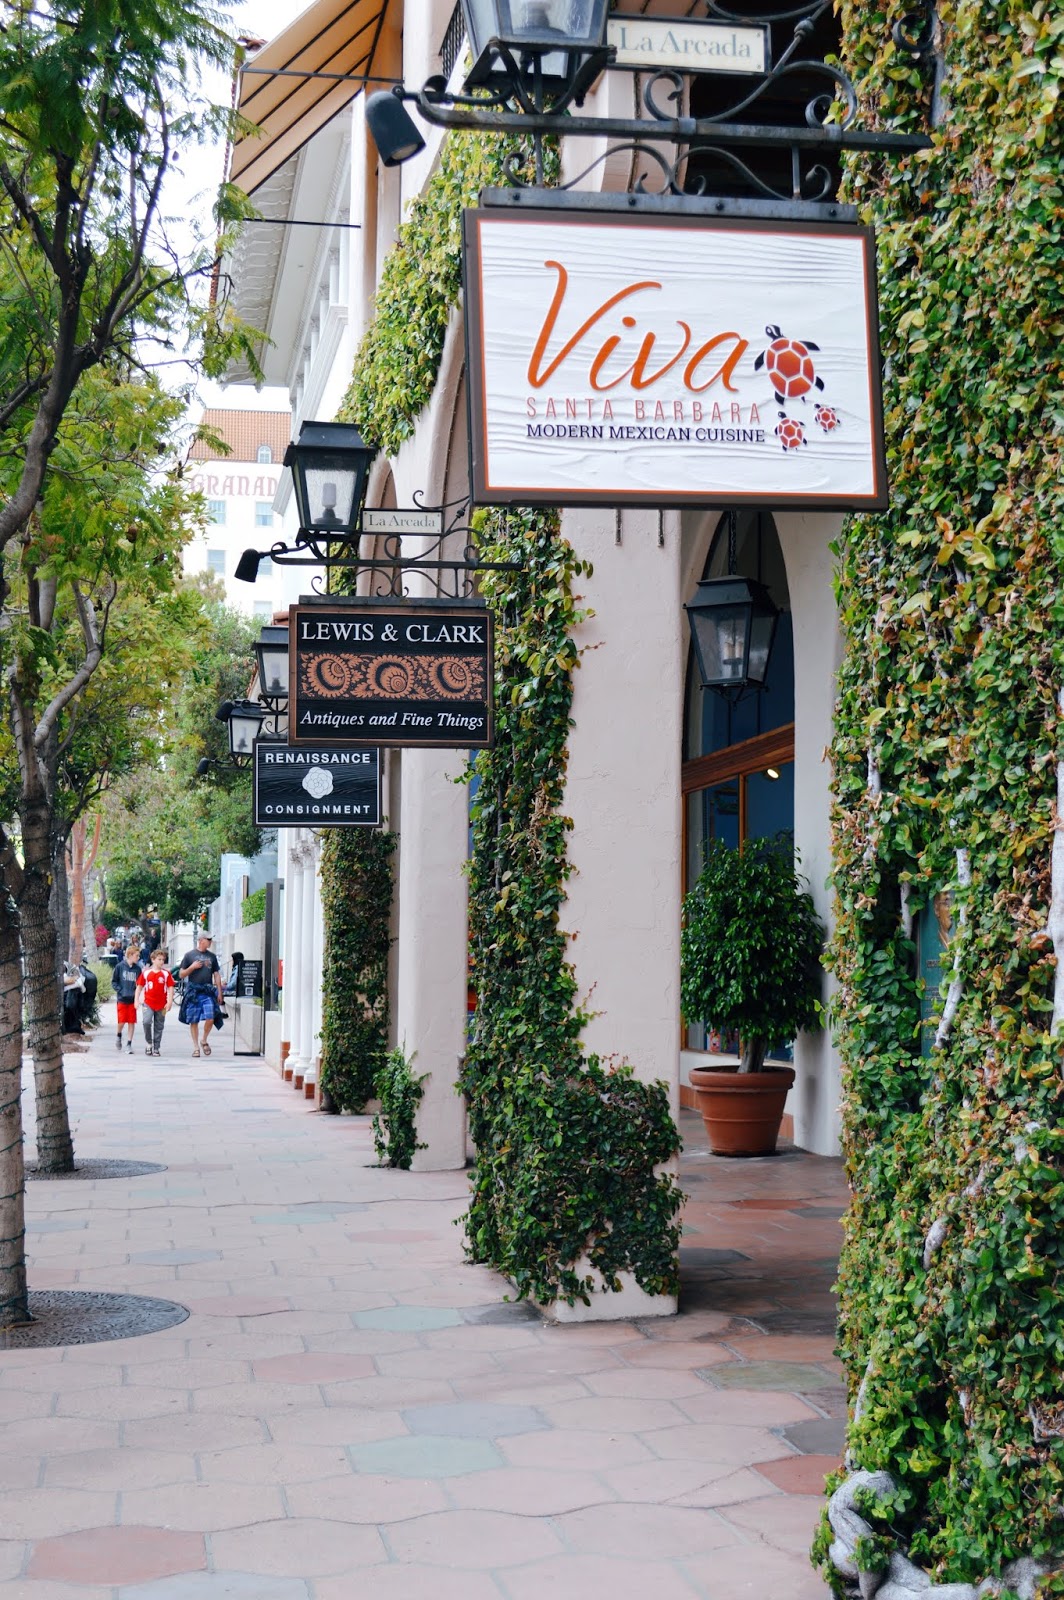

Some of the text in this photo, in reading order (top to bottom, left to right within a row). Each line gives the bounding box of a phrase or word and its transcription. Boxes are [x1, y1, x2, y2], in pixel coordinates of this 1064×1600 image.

[619, 26, 752, 58] La Arcada
[527, 259, 750, 393] Viva
[526, 396, 761, 424] SANTA BARBARA
[526, 423, 766, 443] MODERN MEXICAN CUISINE
[368, 514, 435, 528] La Arcada
[301, 621, 485, 644] LEWIS & CLARK
[300, 710, 484, 731] Antiques and Fine Things
[265, 753, 371, 764] RENAISSANCE
[265, 804, 371, 814] CONSIGNMENT
